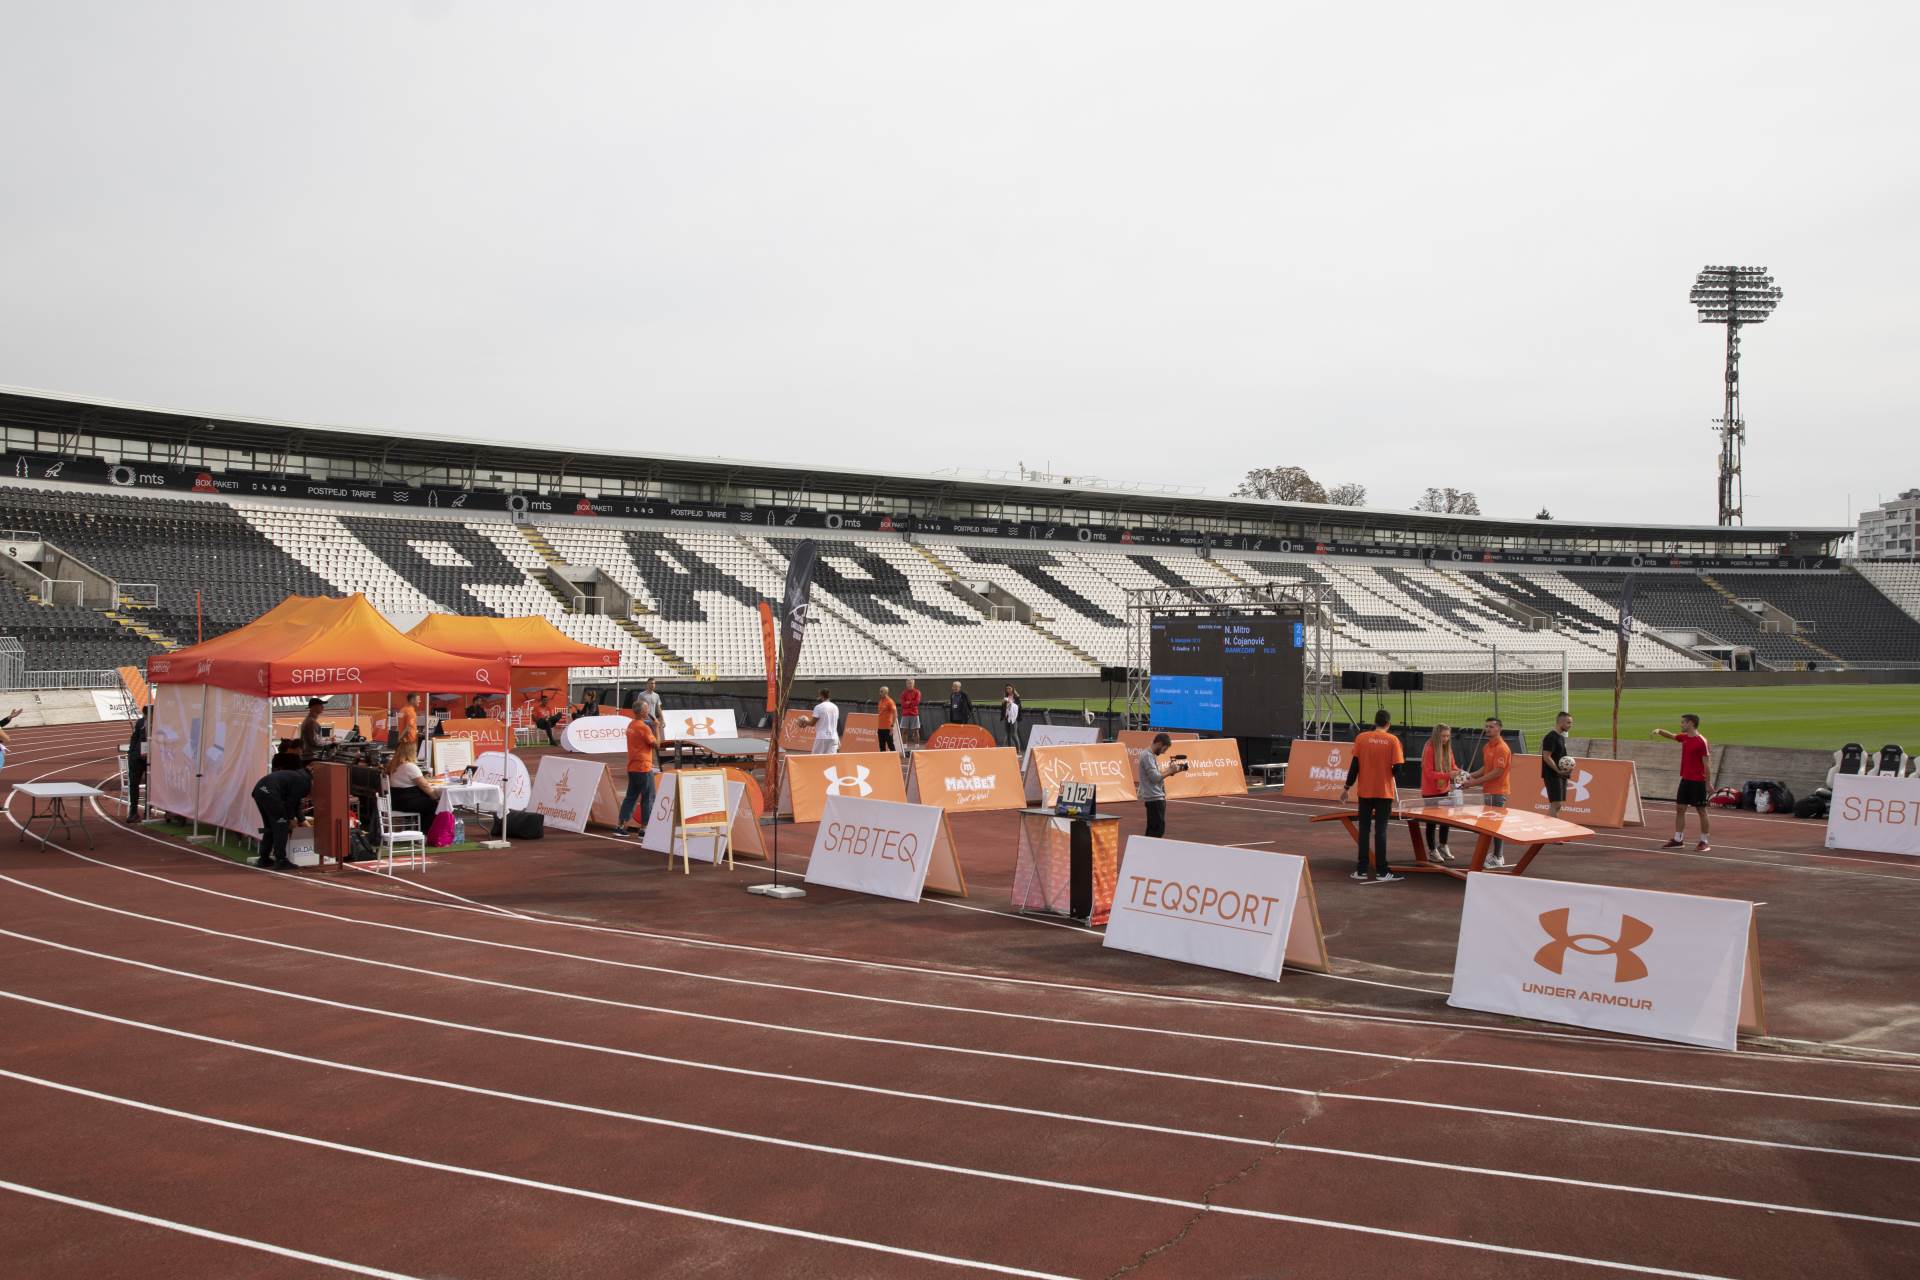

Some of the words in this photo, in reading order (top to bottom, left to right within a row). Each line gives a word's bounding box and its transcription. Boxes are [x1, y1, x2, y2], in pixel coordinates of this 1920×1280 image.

[139, 473, 165, 485] mts
[195, 478, 211, 487] BOX
[213, 480, 239, 489] PAKETI
[308, 486, 347, 497] POSTPEJD
[352, 489, 377, 499] TARIFE
[531, 500, 552, 510] mts
[591, 504, 613, 513] PAKETI
[670, 508, 704, 517] POSTPEJD
[706, 511, 727, 519] TARIFE
[844, 519, 861, 528] mts
[1093, 532, 1107, 541] mts
[9, 546, 17, 557] S
[1224, 625, 1232, 634] N.
[1233, 625, 1250, 634] Mitro
[1224, 637, 1232, 645] N.
[291, 667, 363, 684] SRBTEQ
[449, 729, 504, 742] EQBALL
[576, 728, 627, 739] TEQSPOR
[1191, 759, 1214, 769] Watch
[1214, 758, 1225, 767] GS
[1226, 758, 1238, 767] Pro
[1077, 787, 1087, 801] 12
[536, 802, 577, 821] Promenada
[824, 822, 918, 872] SRBTEQ
[1130, 875, 1279, 926] TEQSPORT
[1522, 982, 1576, 999] UNDER
[1579, 991, 1653, 1011] ARMOUR
